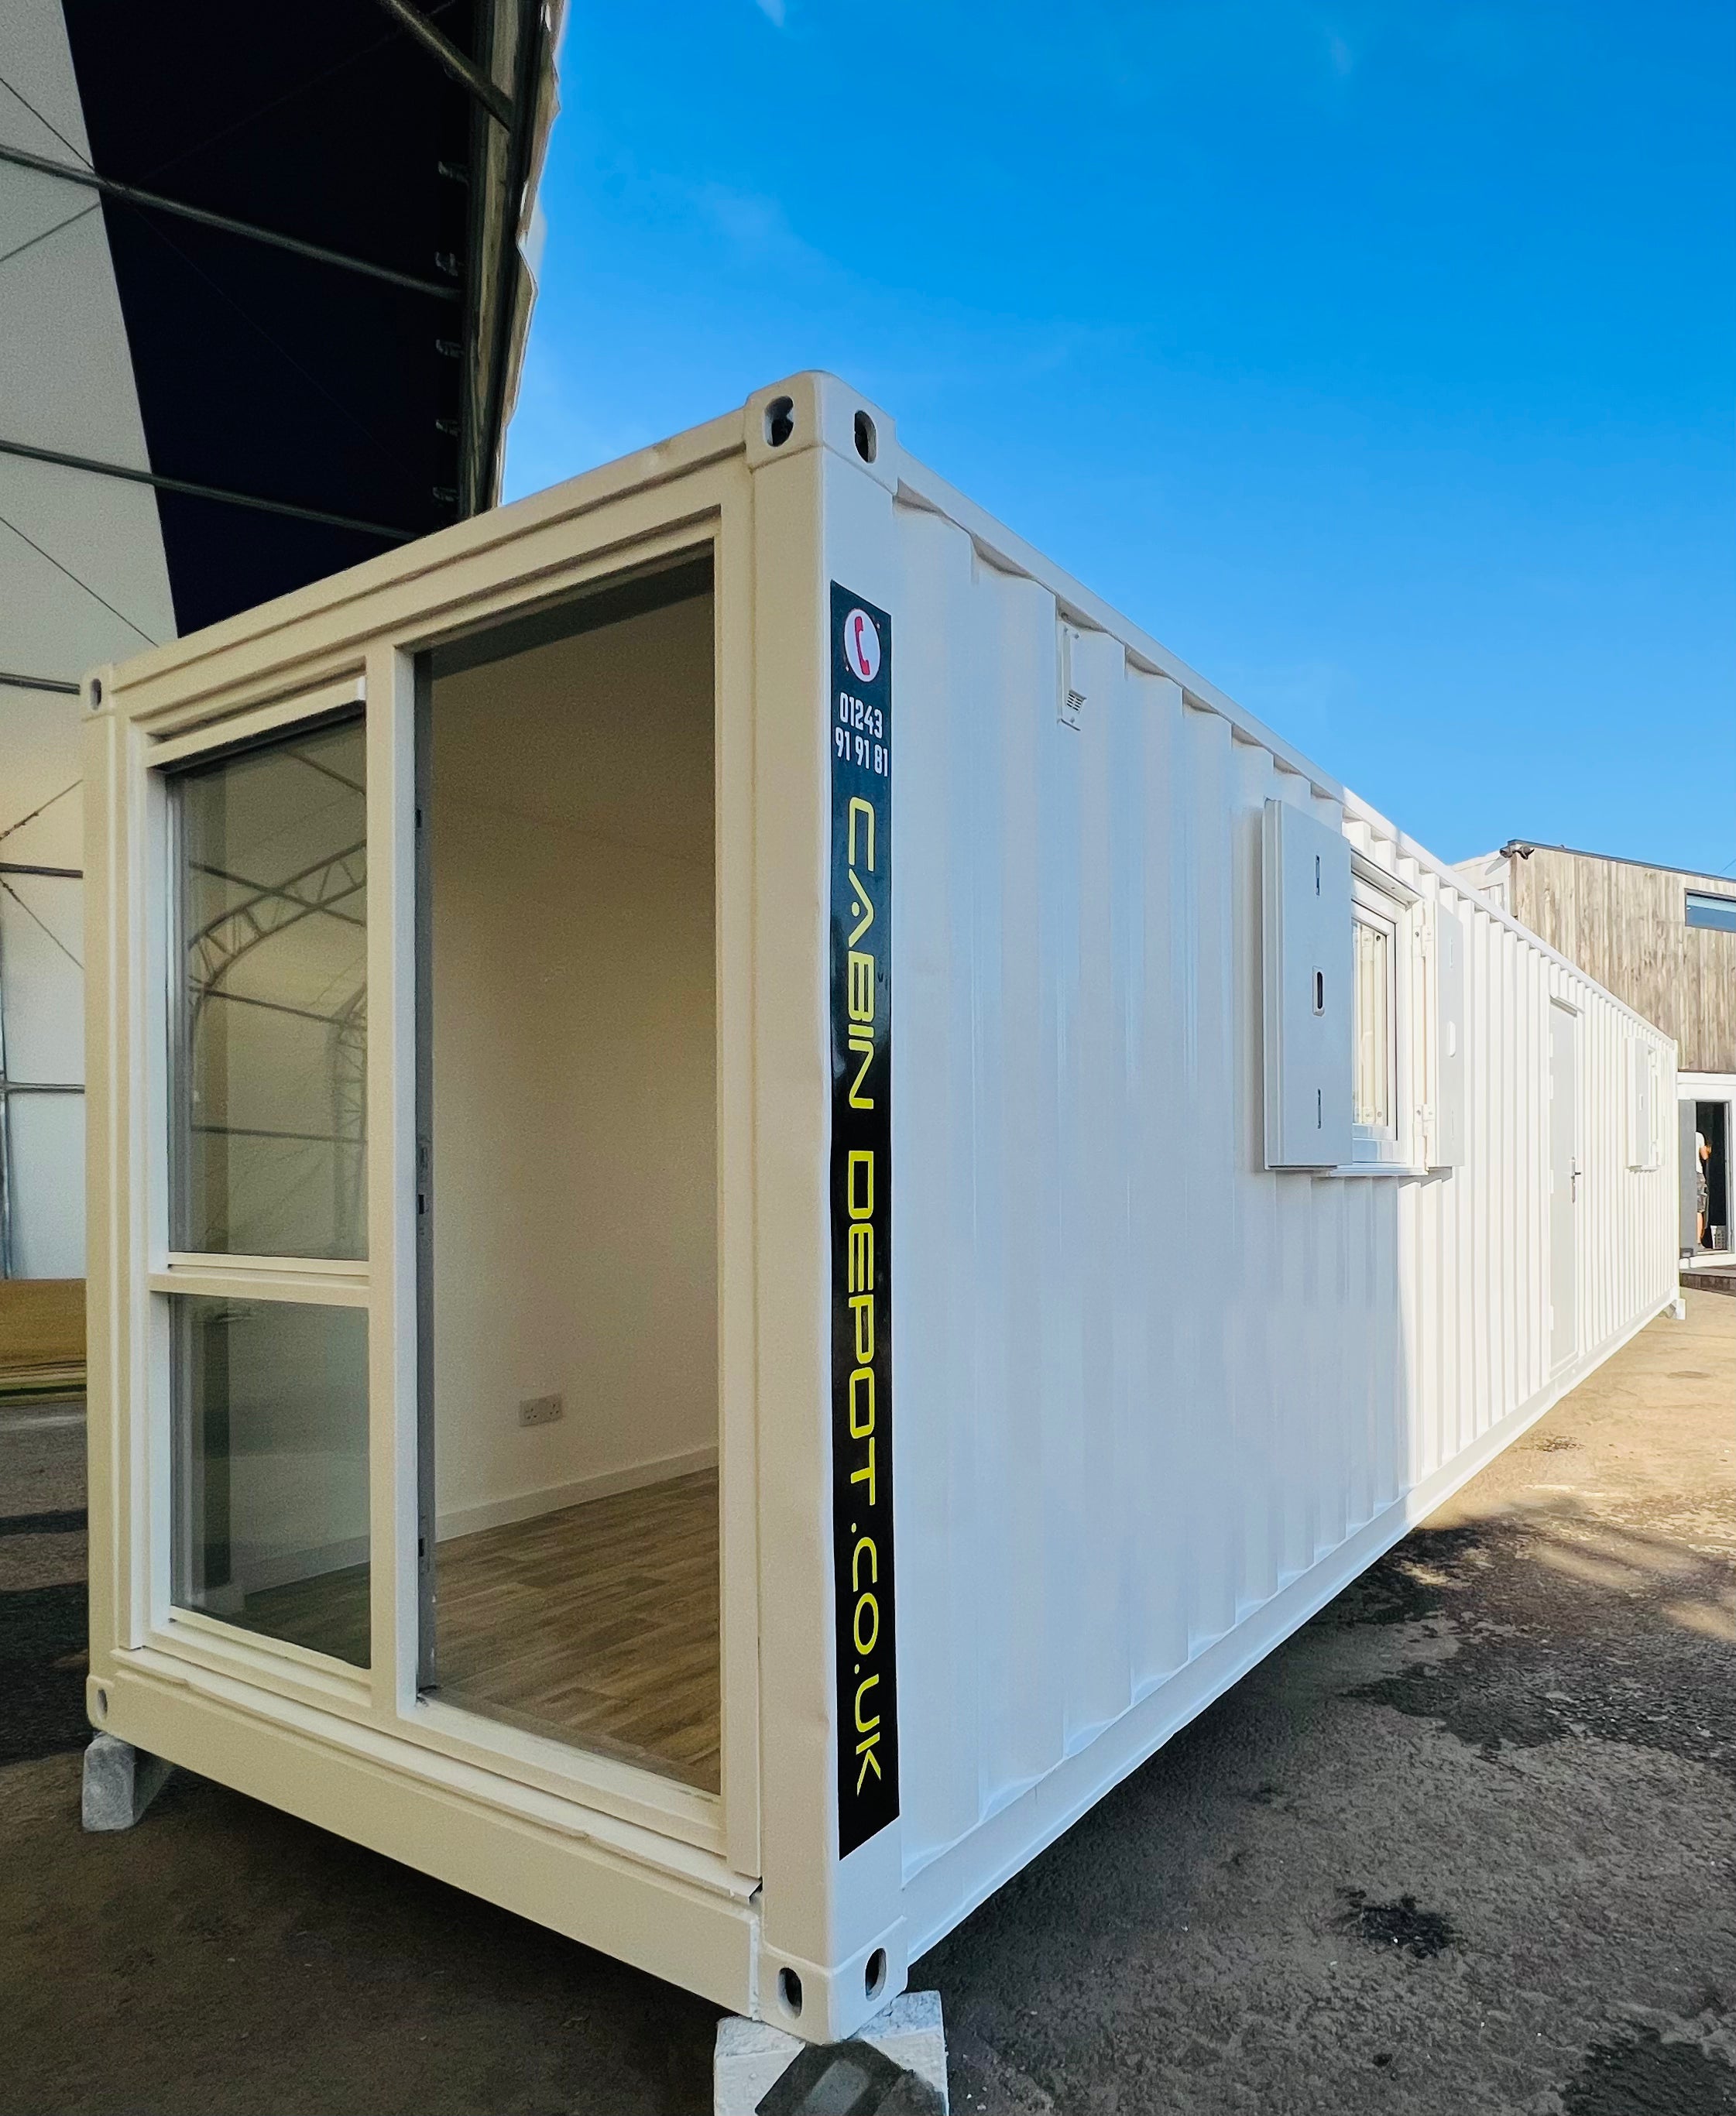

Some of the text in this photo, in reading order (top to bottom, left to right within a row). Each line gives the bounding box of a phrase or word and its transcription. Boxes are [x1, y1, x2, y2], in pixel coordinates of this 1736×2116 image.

[839, 692, 883, 739] 01243
[835, 726, 888, 777] 91 91 81
[848, 796, 875, 1109] CABIN
